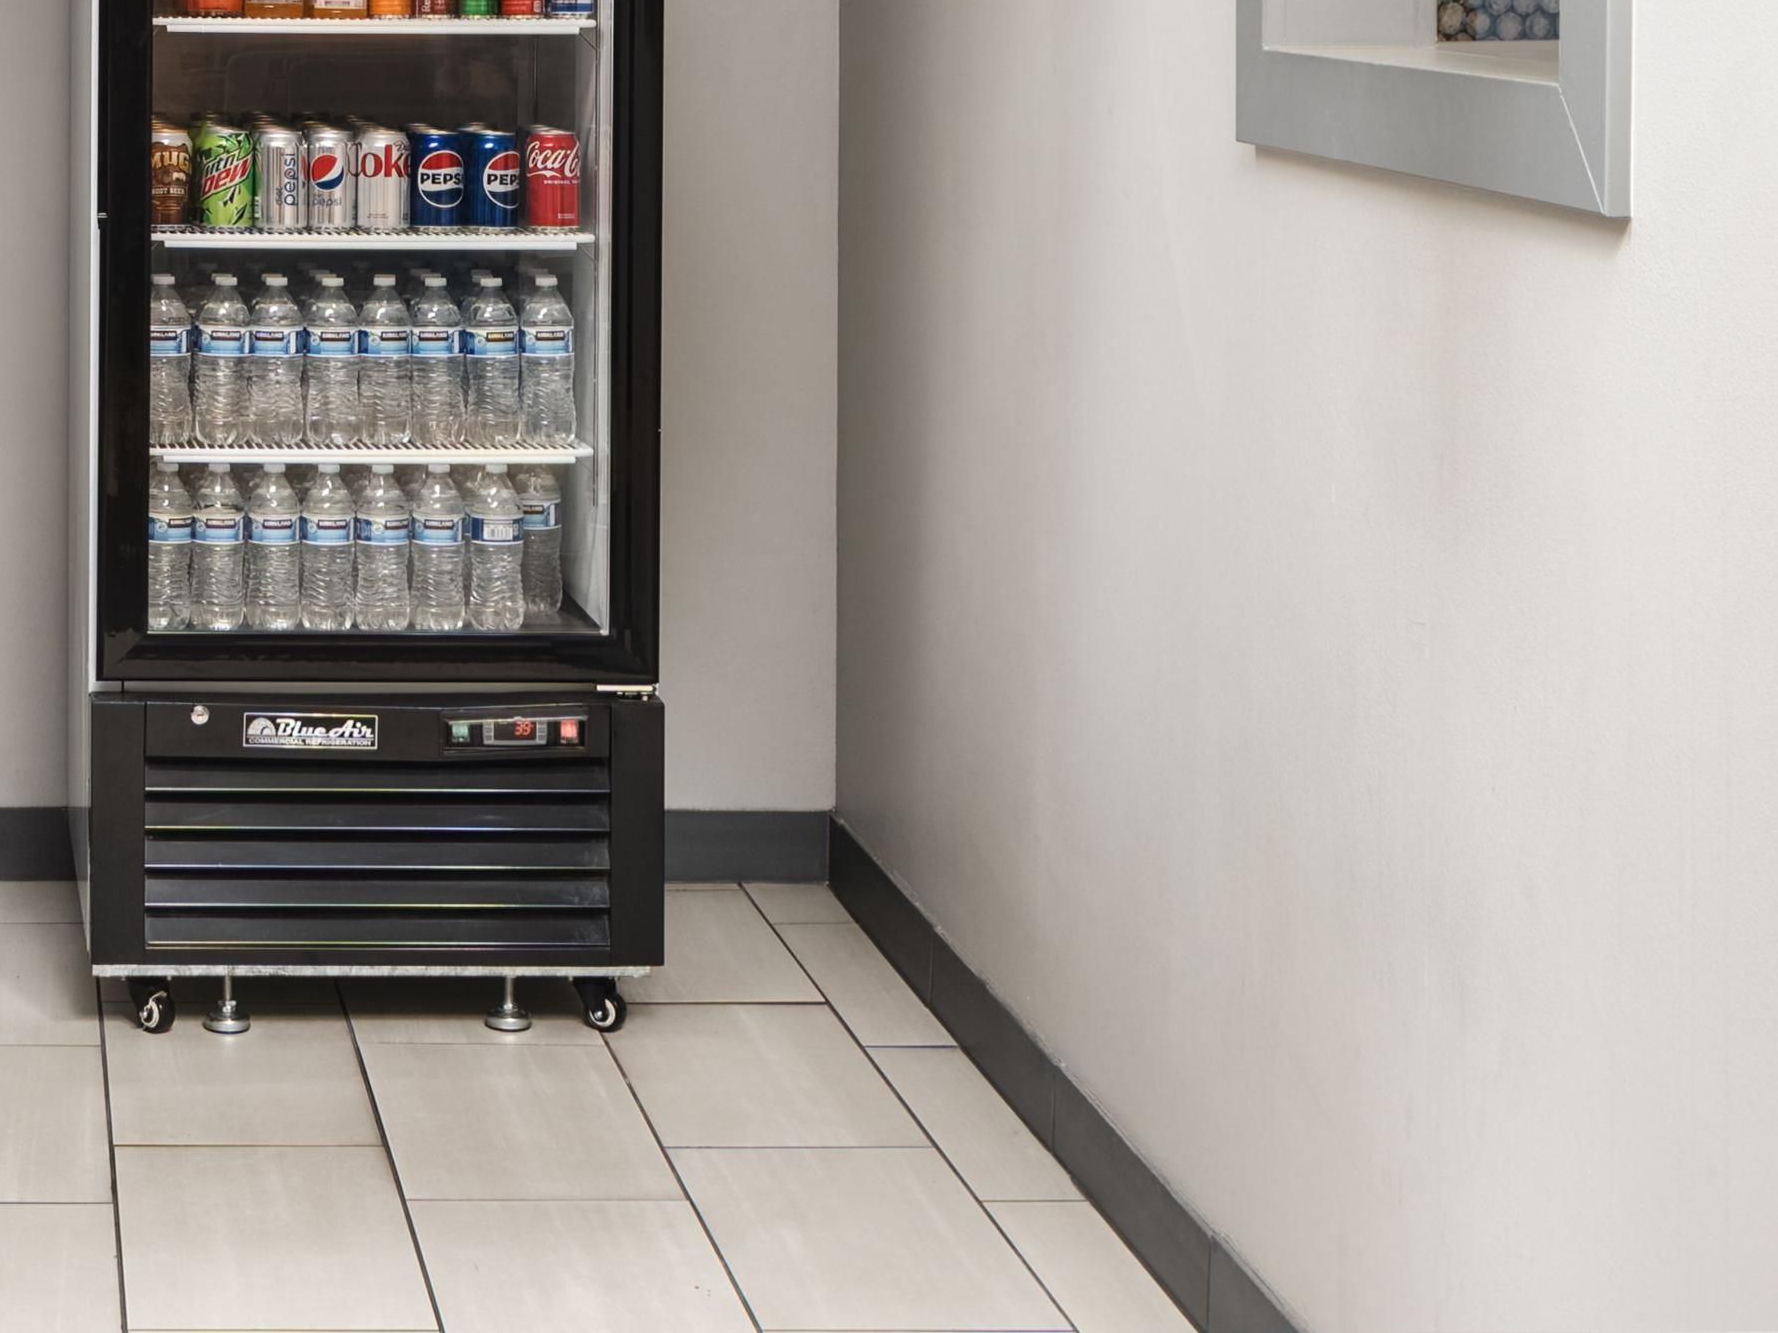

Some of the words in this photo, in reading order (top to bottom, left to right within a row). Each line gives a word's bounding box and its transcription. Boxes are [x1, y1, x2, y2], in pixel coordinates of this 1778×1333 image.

[152, 151, 190, 168] MUG
[284, 153, 296, 206] pepsi
[170, 187, 185, 195] BEER
[514, 721, 532, 736] 39
[249, 738, 304, 746] COMMERCIAL
[305, 738, 371, 747] REFRIGERATION
